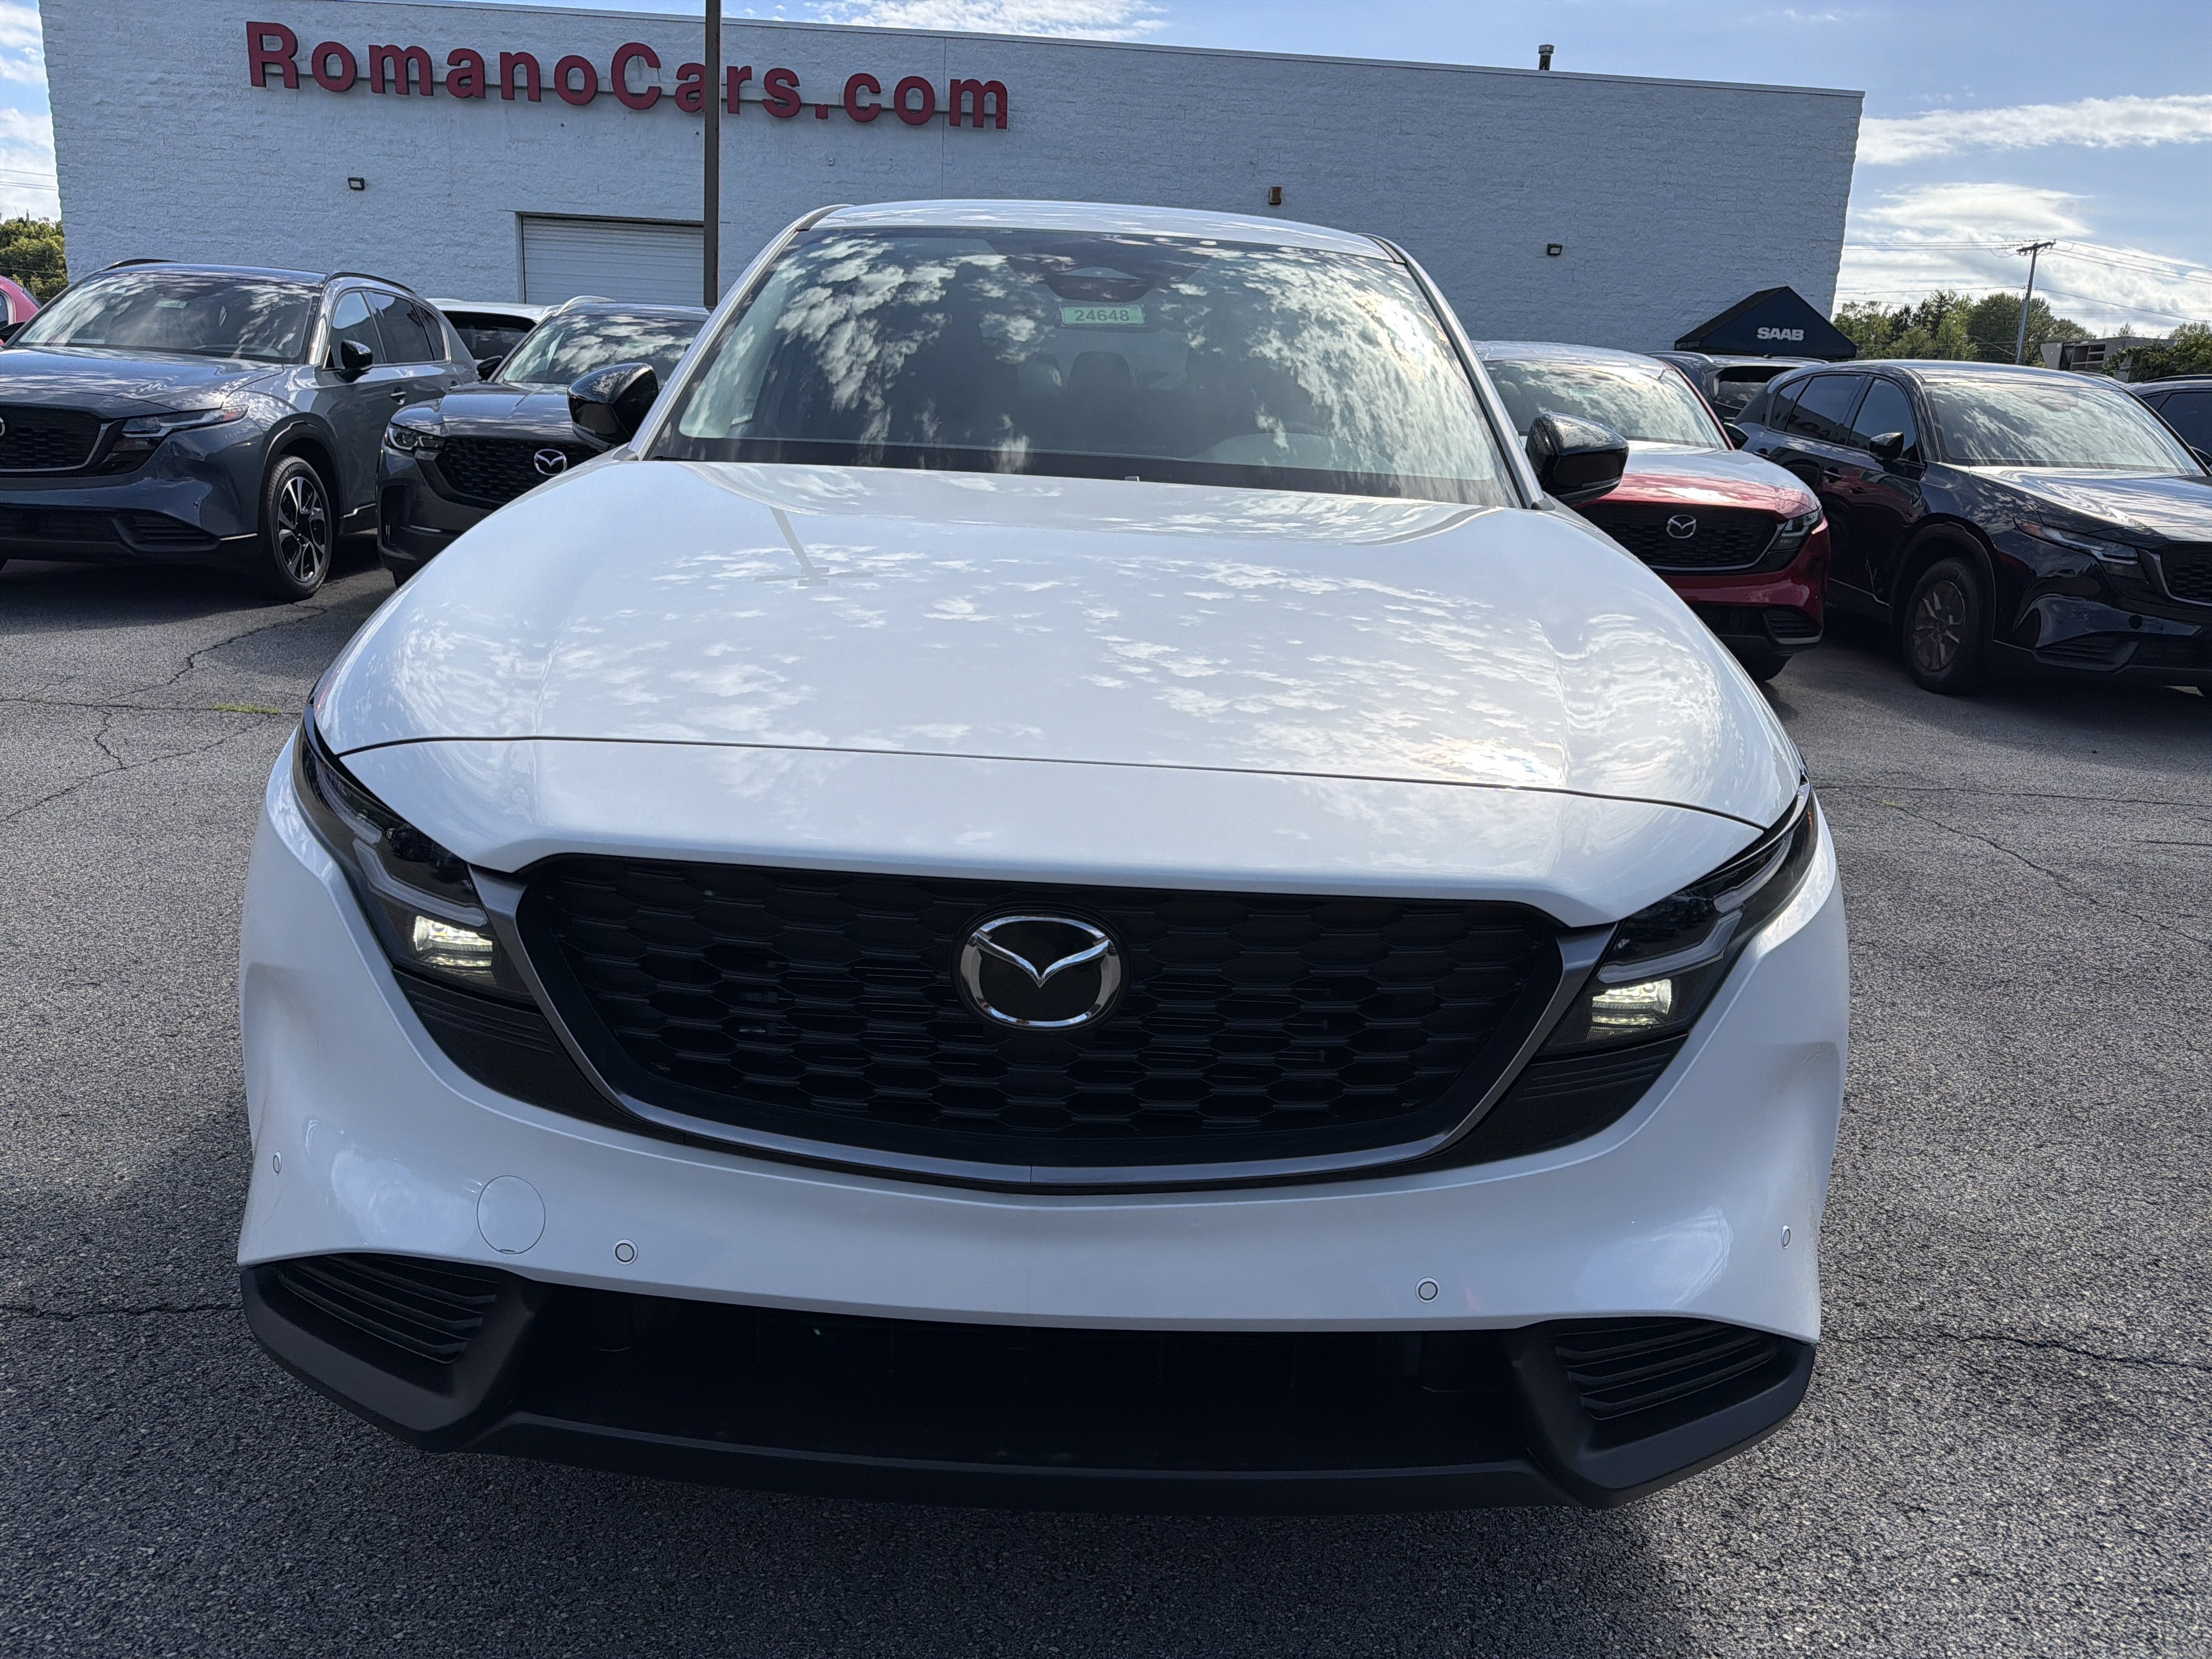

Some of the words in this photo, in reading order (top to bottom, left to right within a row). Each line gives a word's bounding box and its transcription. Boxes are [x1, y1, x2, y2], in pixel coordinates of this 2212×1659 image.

[246, 21, 1008, 129] RomanoCars.com
[1074, 309, 1130, 321] 24648
[1757, 327, 1804, 341] SAAB
